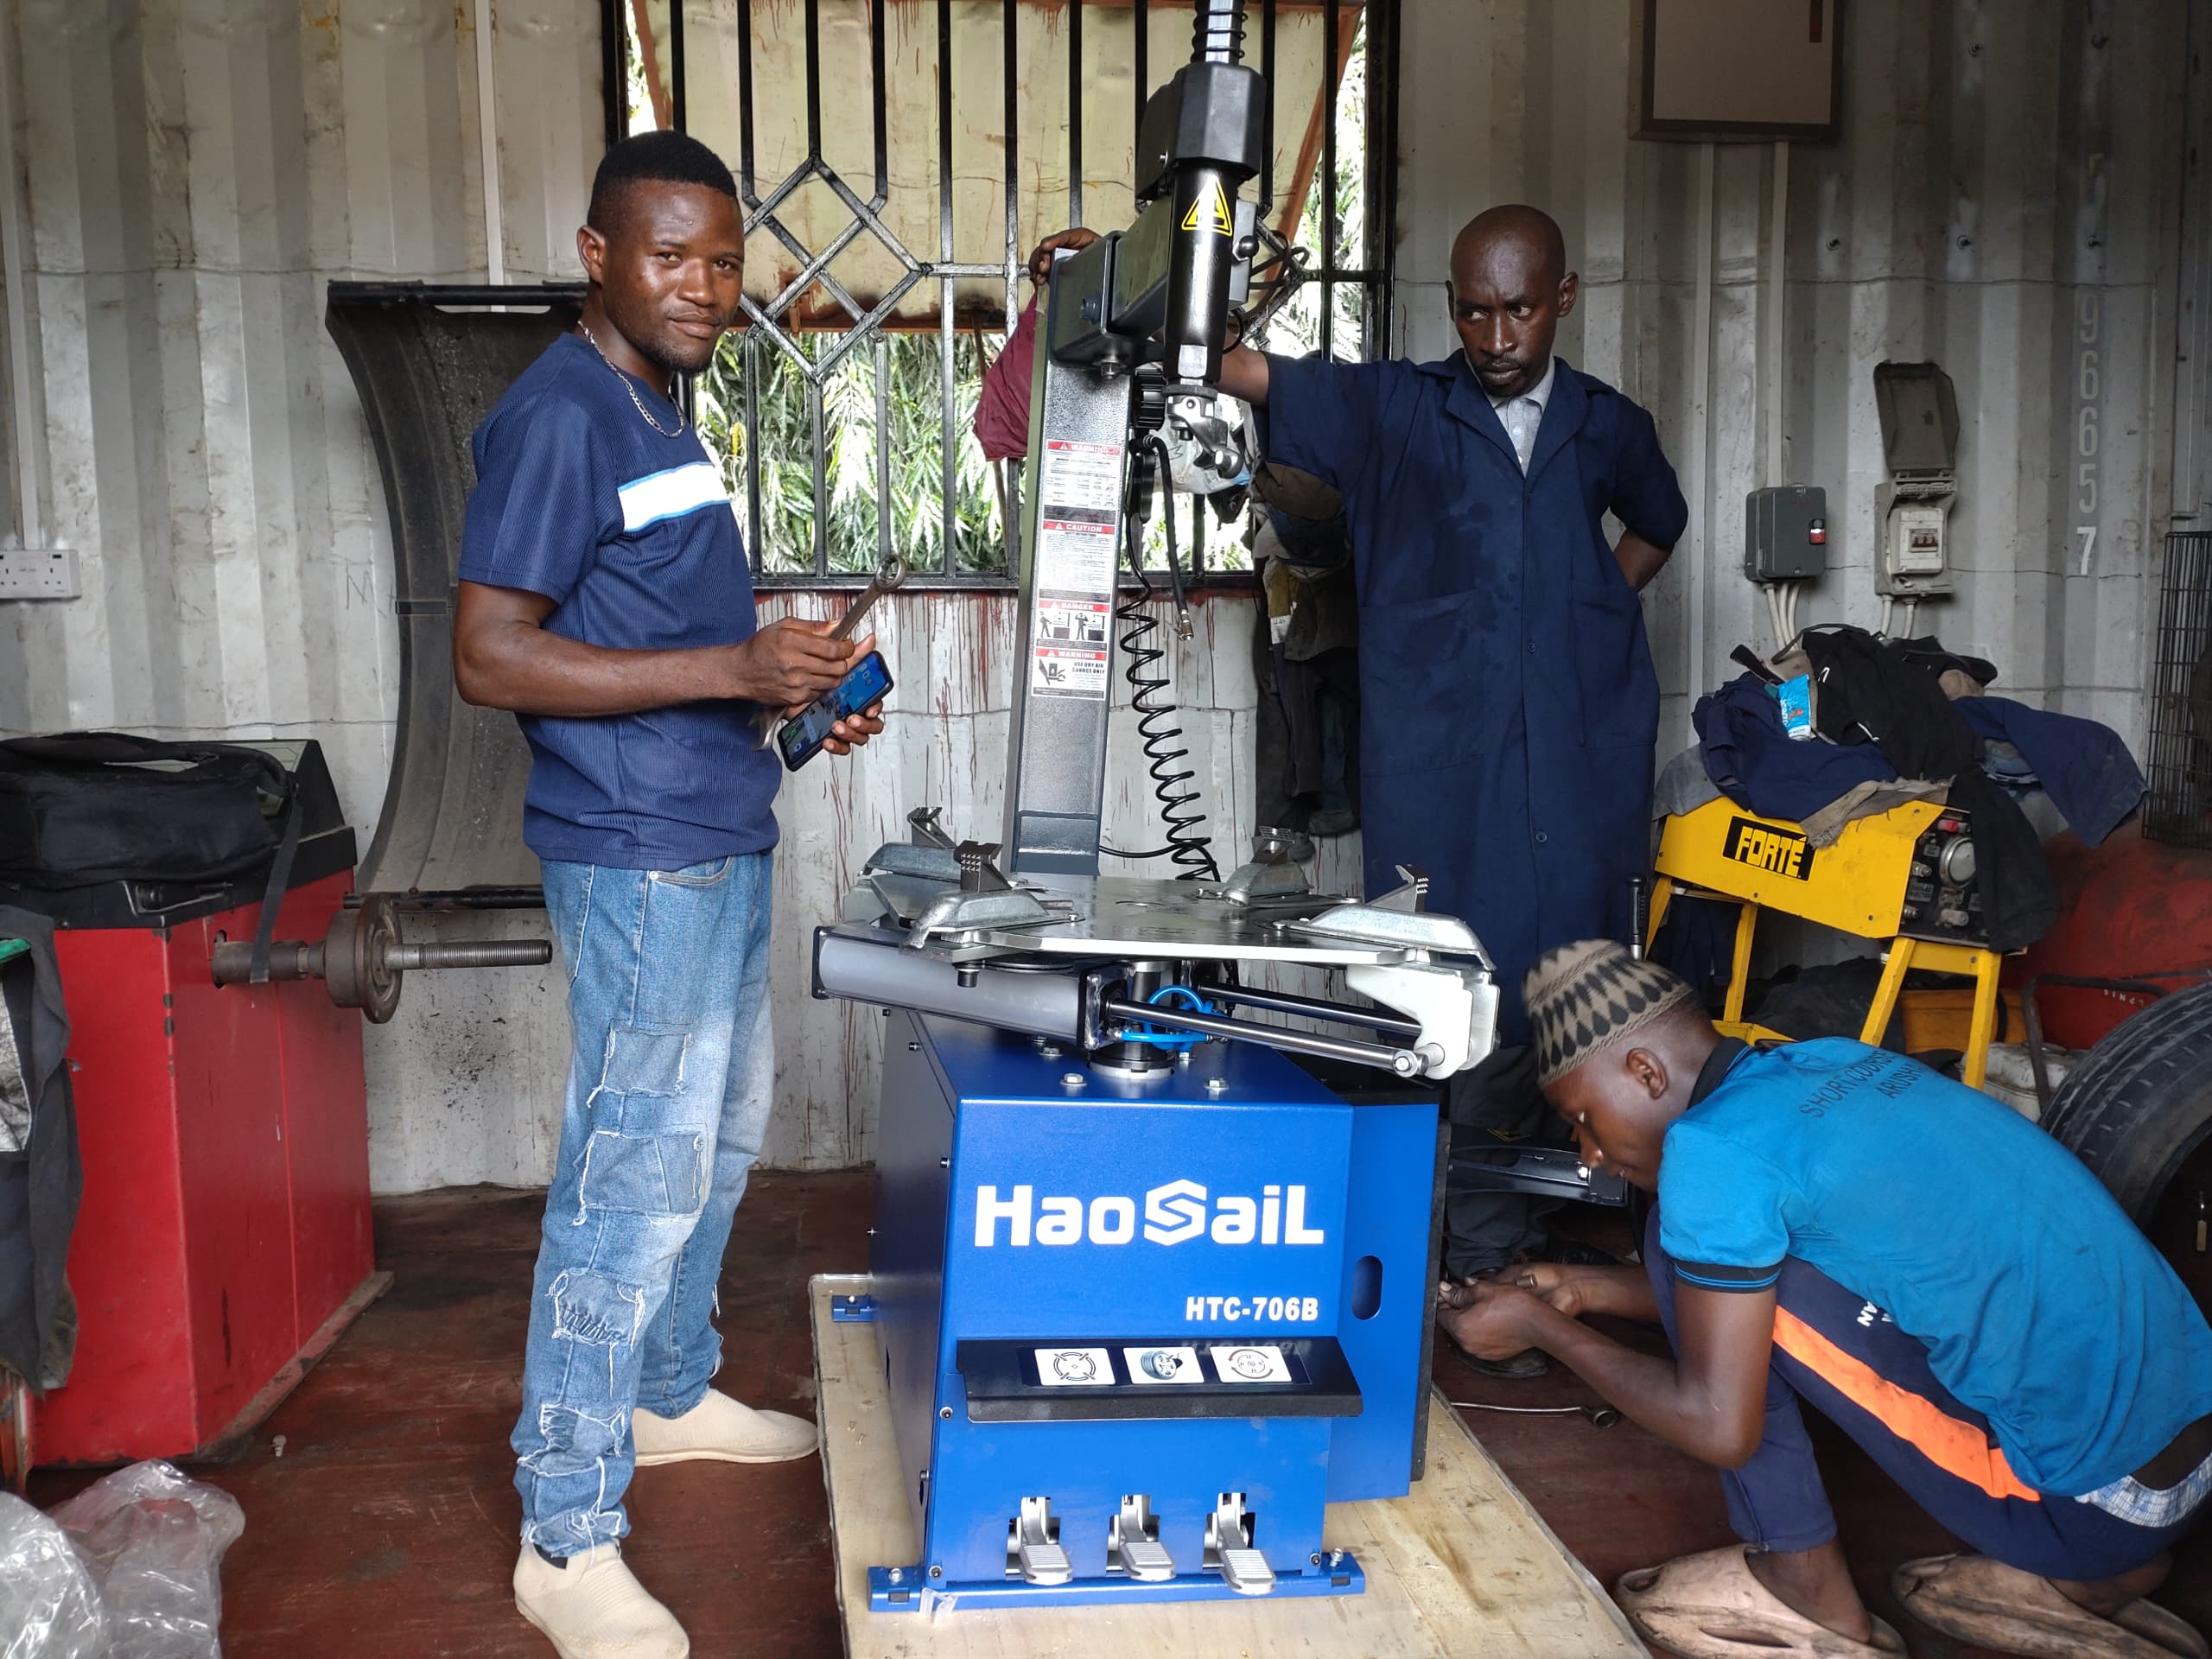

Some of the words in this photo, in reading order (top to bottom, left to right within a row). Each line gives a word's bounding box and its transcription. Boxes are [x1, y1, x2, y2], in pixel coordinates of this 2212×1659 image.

[1058, 650, 1096, 658] WARNING
[1798, 1071, 1858, 1118] SHORT
[1185, 1297, 1319, 1321] HTC-706B
